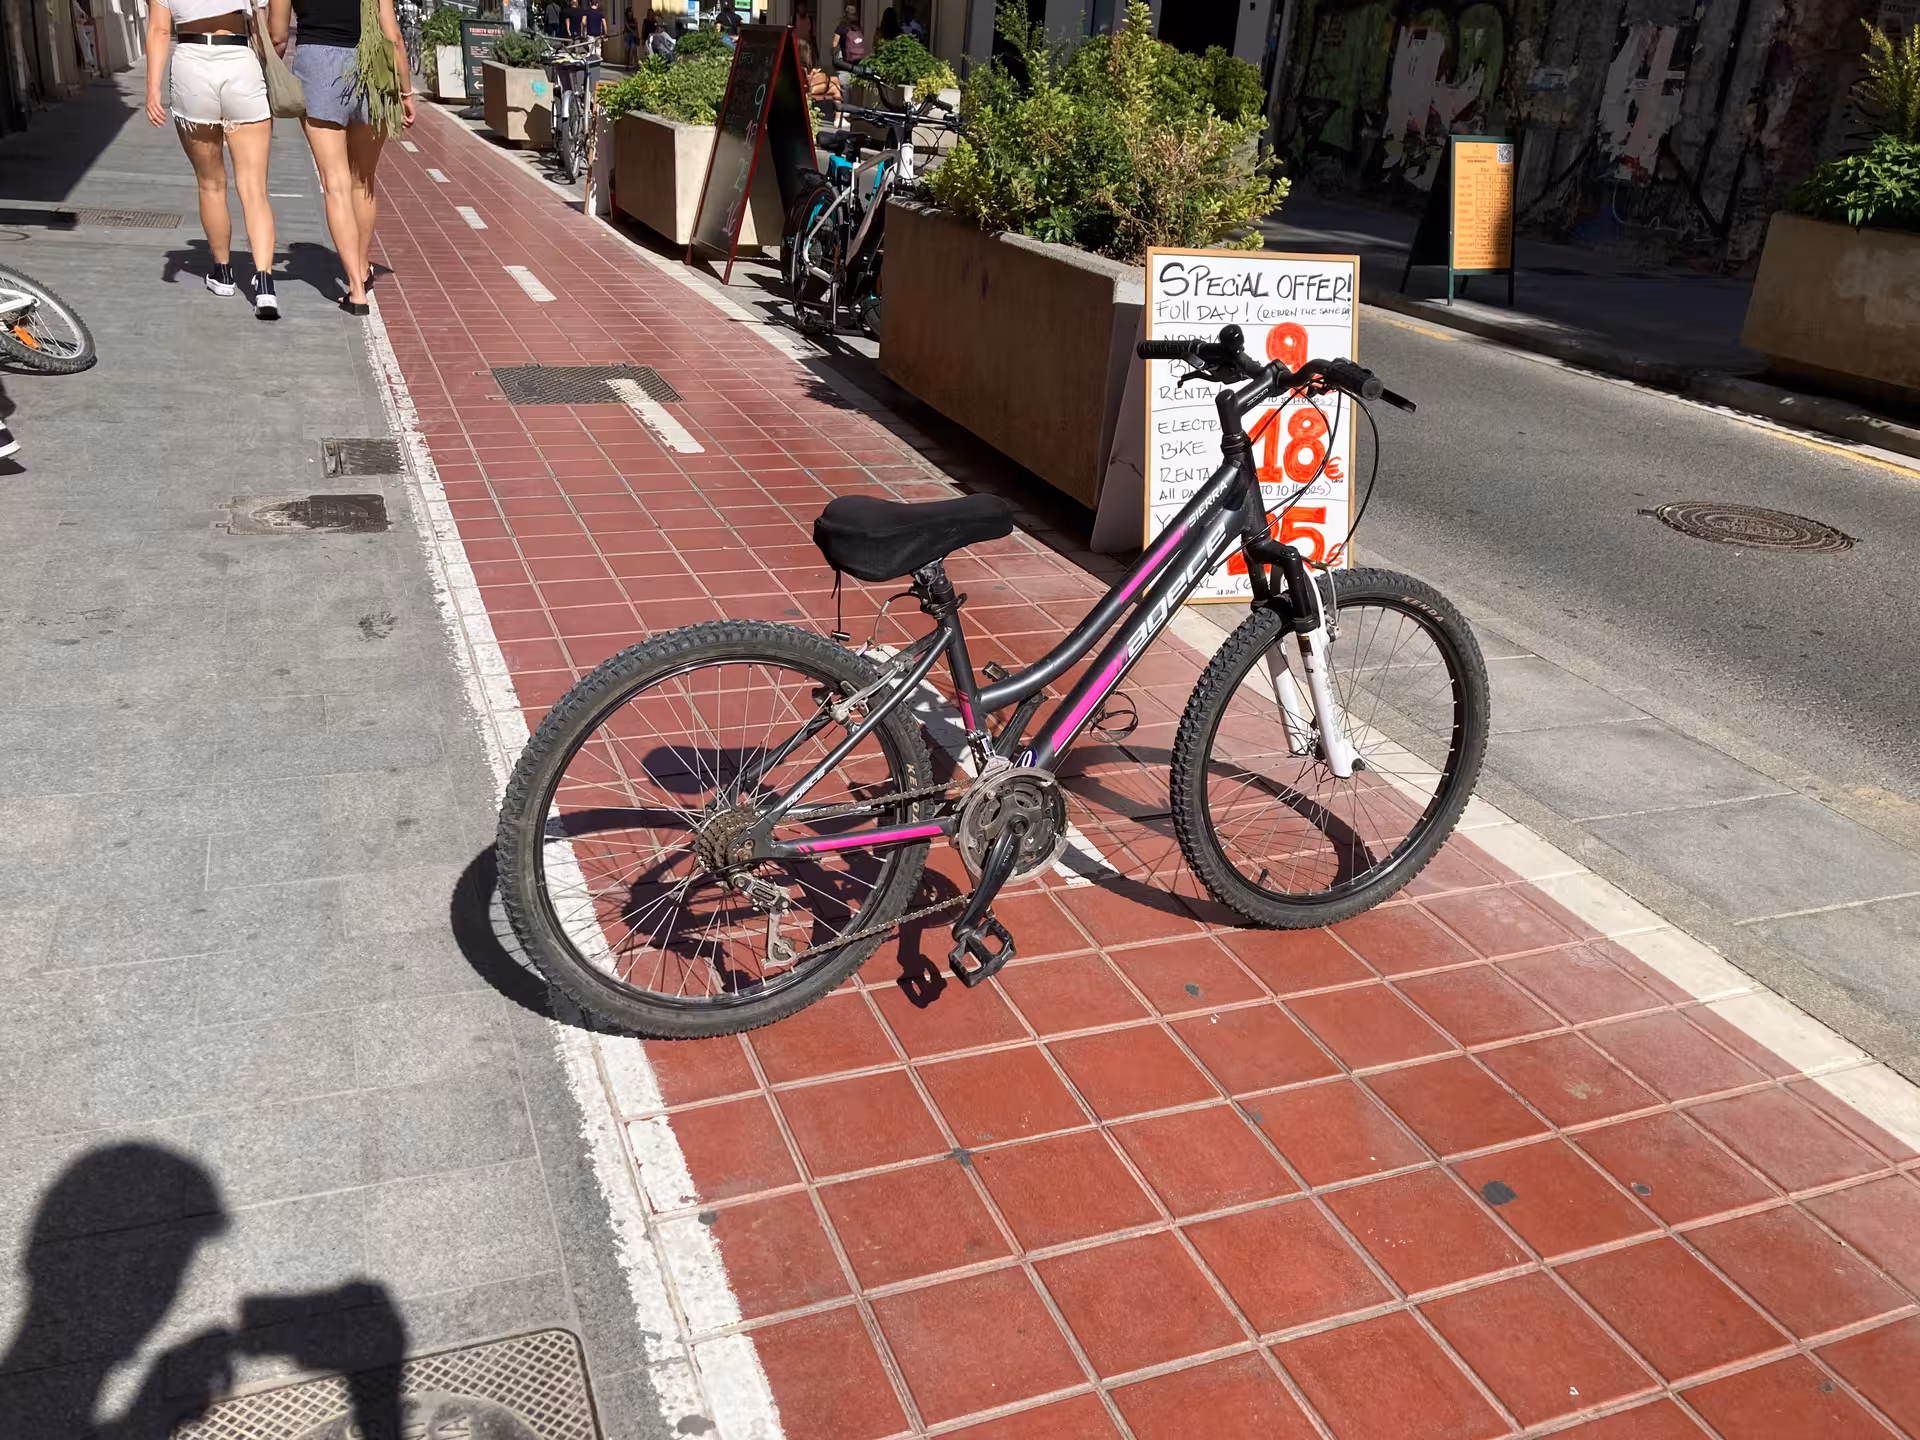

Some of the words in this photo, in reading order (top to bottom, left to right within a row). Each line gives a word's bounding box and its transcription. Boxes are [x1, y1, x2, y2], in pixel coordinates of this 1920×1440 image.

[1276, 273, 1352, 302] OFFER!
[1300, 307, 1318, 318] THE
[1159, 465, 1219, 484] RENTA
[1181, 488, 1199, 499] DA
[1276, 483, 1289, 496] 10
[1187, 480, 1229, 528] SIERRA
[1400, 594, 1445, 622] KENDA
[905, 763, 920, 823] KEDA
